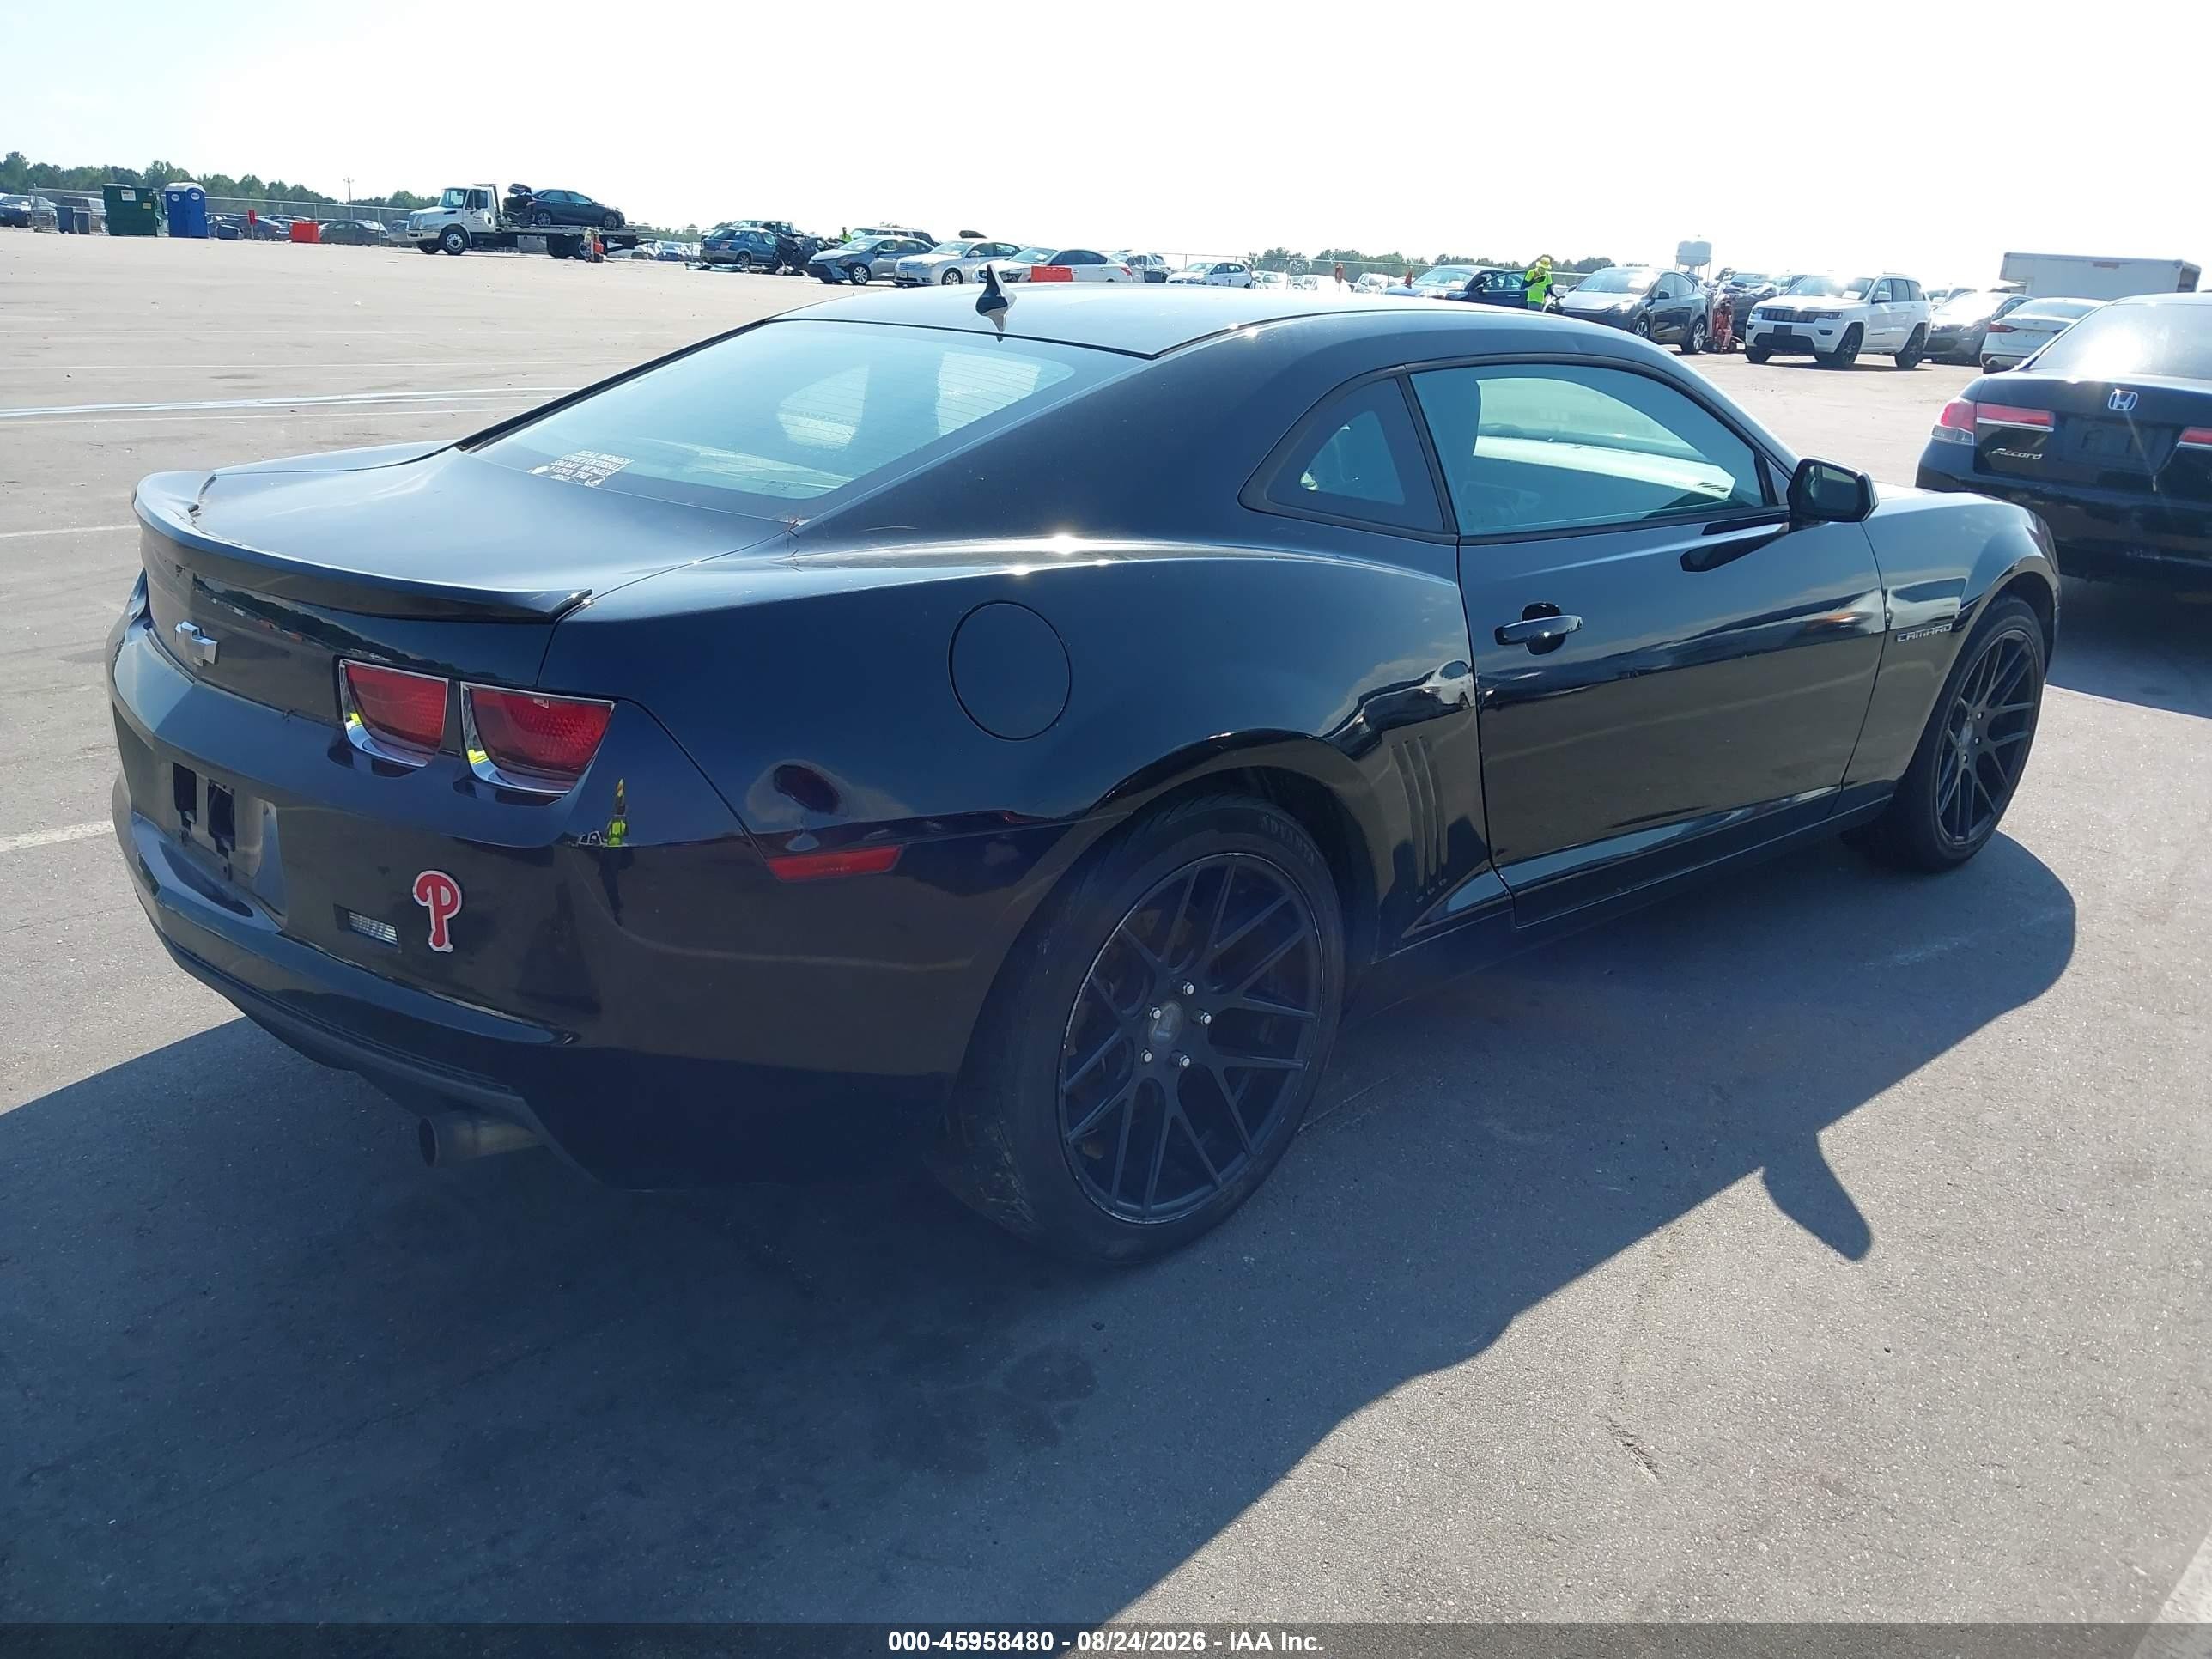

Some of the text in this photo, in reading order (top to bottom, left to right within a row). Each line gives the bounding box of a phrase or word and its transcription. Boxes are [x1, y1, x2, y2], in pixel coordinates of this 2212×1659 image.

[1990, 447, 2043, 460] Accord
[580, 465, 616, 477] WOMEN
[583, 459, 626, 471] FOOTBALL
[1896, 623, 1953, 642] CAMARO
[414, 871, 462, 953] P
